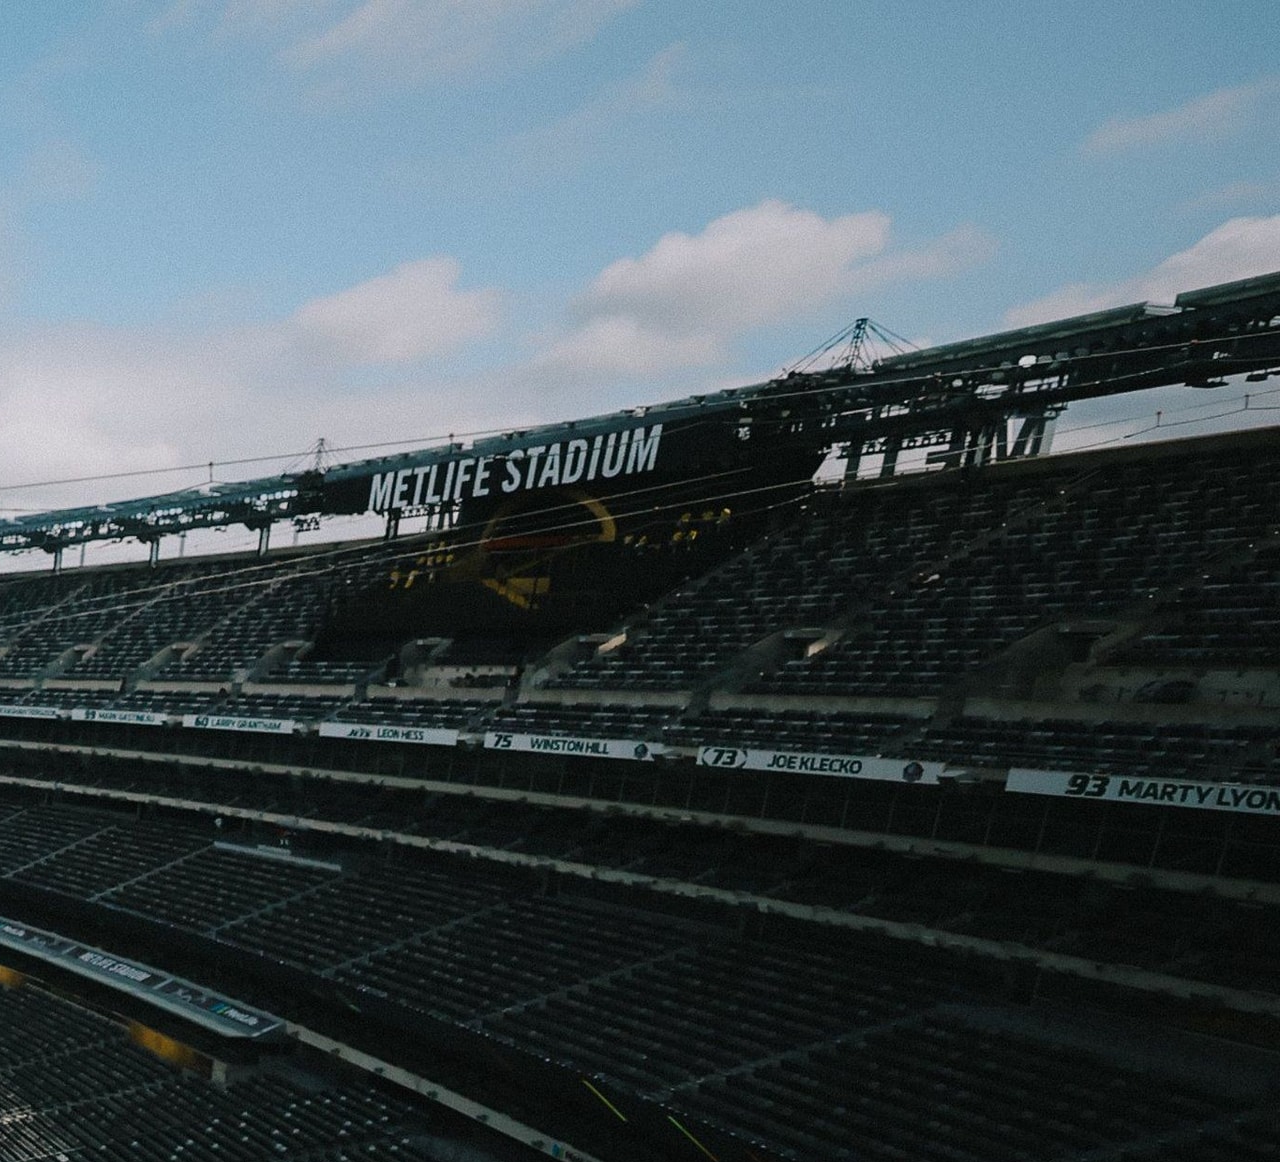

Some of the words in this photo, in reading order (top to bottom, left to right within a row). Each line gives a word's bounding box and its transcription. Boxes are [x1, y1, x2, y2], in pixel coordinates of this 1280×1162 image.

[367, 457, 491, 512] METLIFE
[501, 424, 663, 493] STADIUM
[195, 717, 208, 727] 60
[377, 728, 400, 738] LEON
[401, 730, 424, 741] HESS
[494, 734, 513, 748] 75
[530, 737, 584, 752] WINSTON
[585, 742, 609, 755] HILL
[712, 749, 738, 766] 73
[767, 754, 796, 769] JOE
[798, 756, 862, 774] KLECKO
[1065, 774, 1110, 797] 93
[1118, 780, 1214, 804] MARTY
